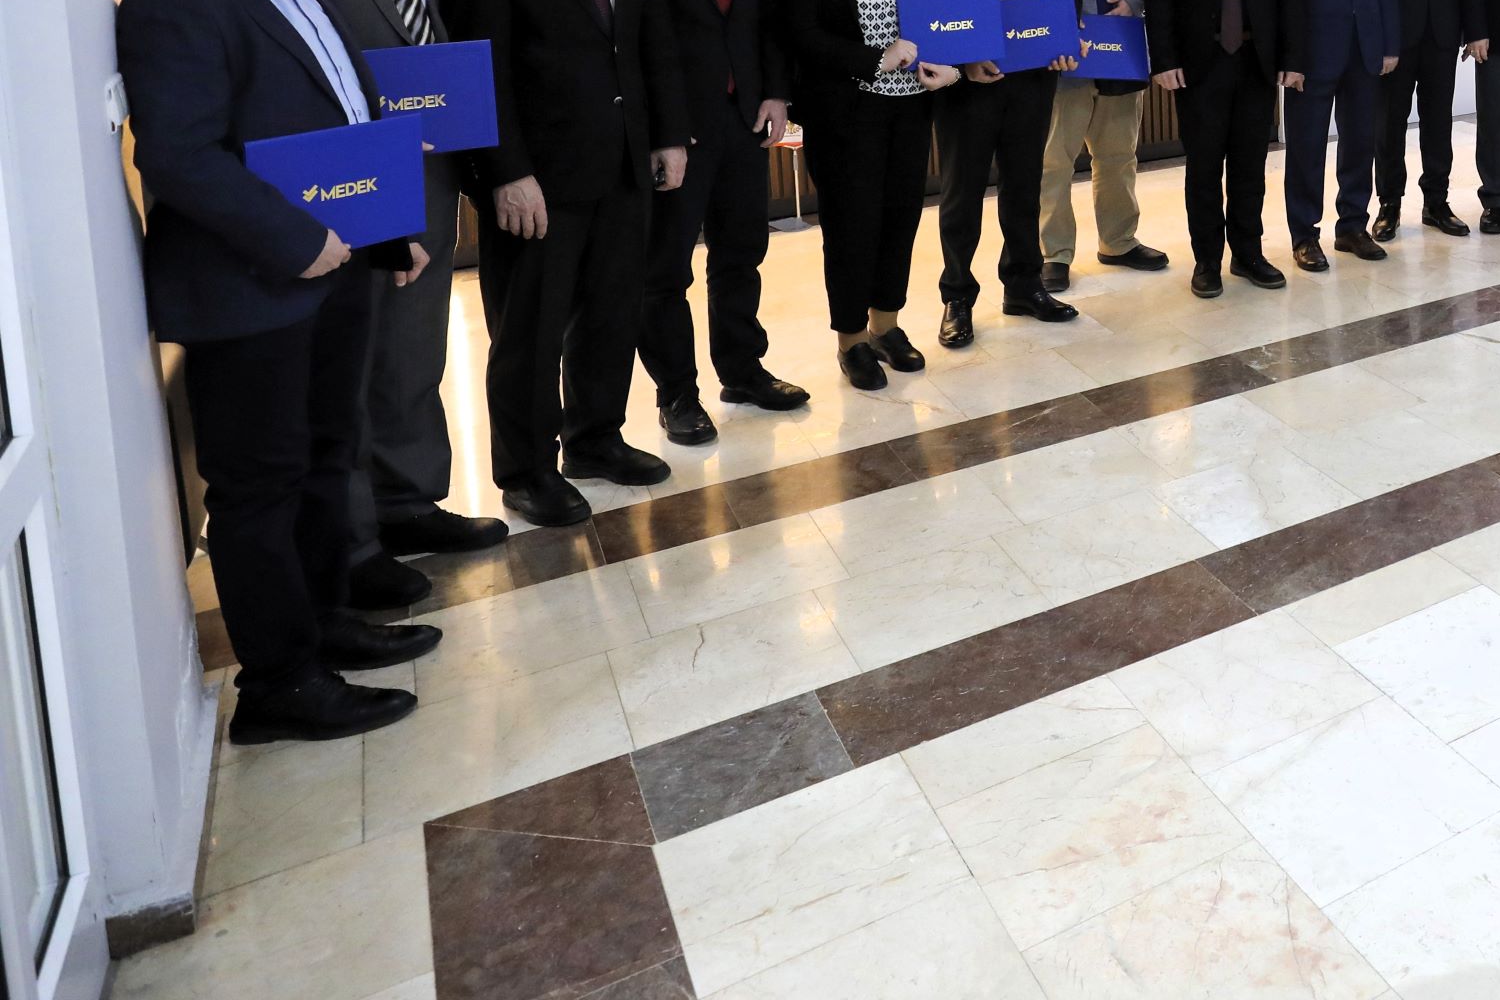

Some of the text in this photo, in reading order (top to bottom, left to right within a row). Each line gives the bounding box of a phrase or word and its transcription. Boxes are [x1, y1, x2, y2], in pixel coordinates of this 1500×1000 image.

[940, 20, 974, 32] MEDEK
[1016, 26, 1051, 39] MEDEK
[1093, 43, 1122, 52] MEDEK
[389, 94, 446, 111] MEDEK
[320, 177, 378, 202] MEDEK
